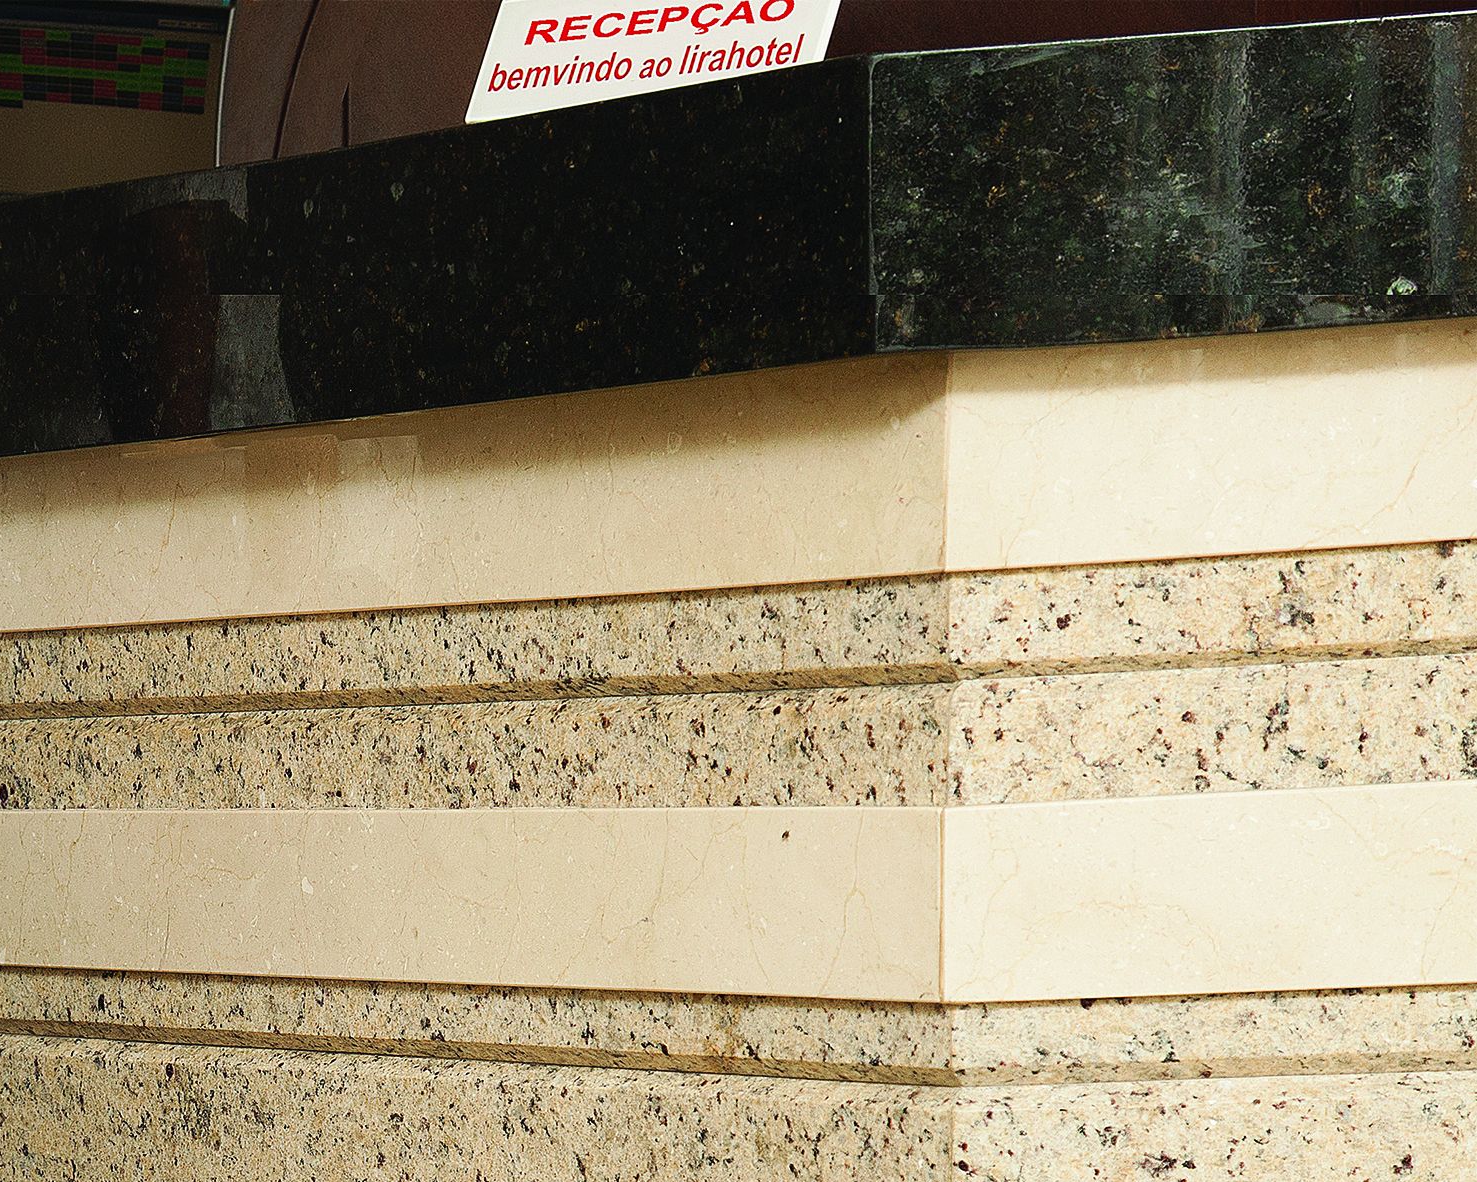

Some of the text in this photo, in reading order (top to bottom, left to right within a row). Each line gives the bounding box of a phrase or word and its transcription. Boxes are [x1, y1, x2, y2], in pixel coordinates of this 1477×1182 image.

[488, 33, 805, 93] bemvindo ao lirahotel
